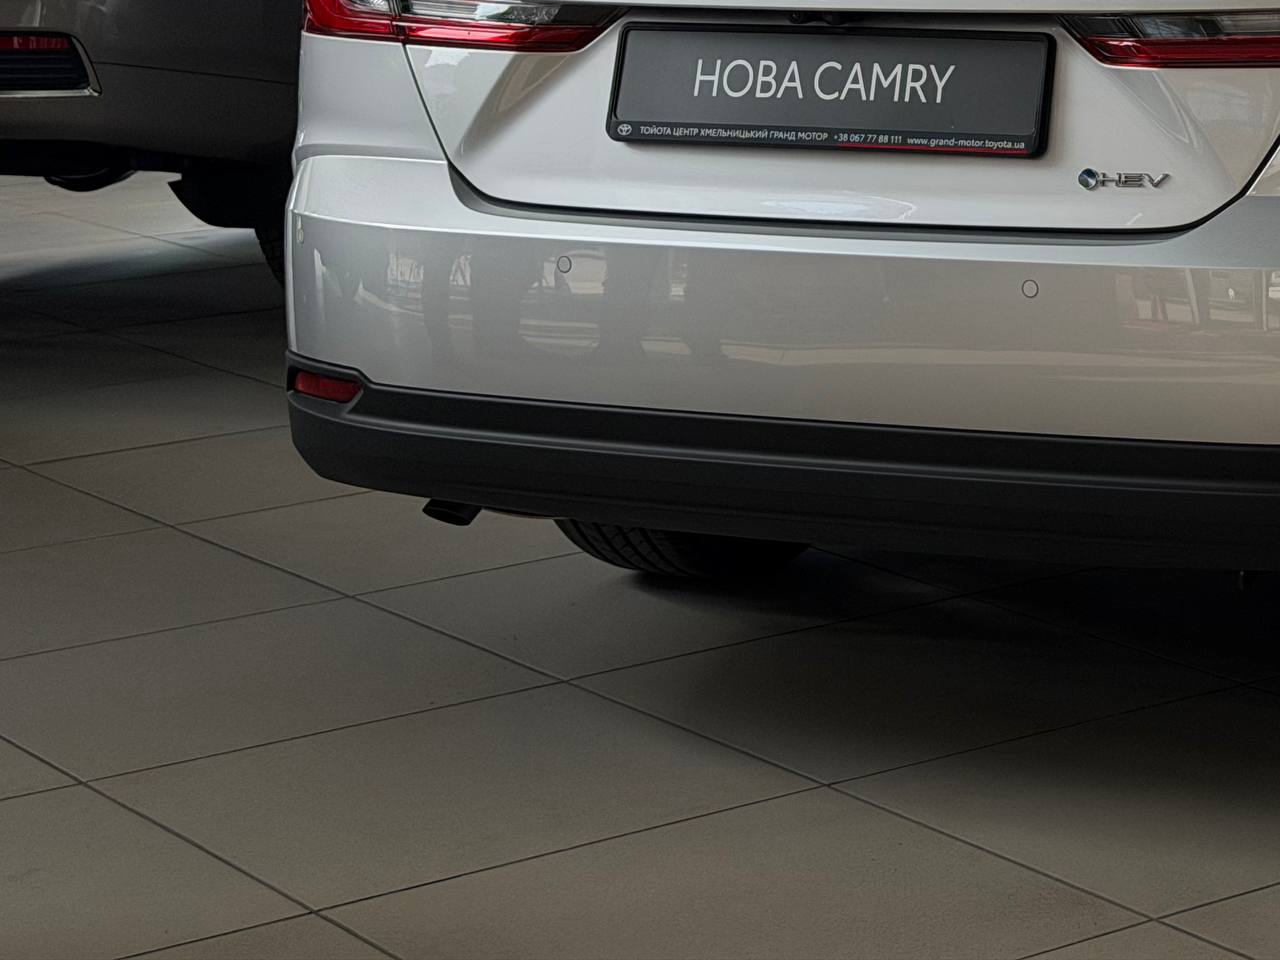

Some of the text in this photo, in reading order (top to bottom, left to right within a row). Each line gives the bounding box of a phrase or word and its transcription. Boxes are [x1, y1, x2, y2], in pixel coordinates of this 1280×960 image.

[692, 57, 957, 105] НОВА CAMRY
[639, 125, 1026, 150] ТОЙОТА ЦЕНТР ХМЕЛЬНИЦЬКИЙ ГРАНД МОТОР +38 067 77 88 111 www.grand-motor.toyota.ua
[1099, 171, 1171, 188] HEV
